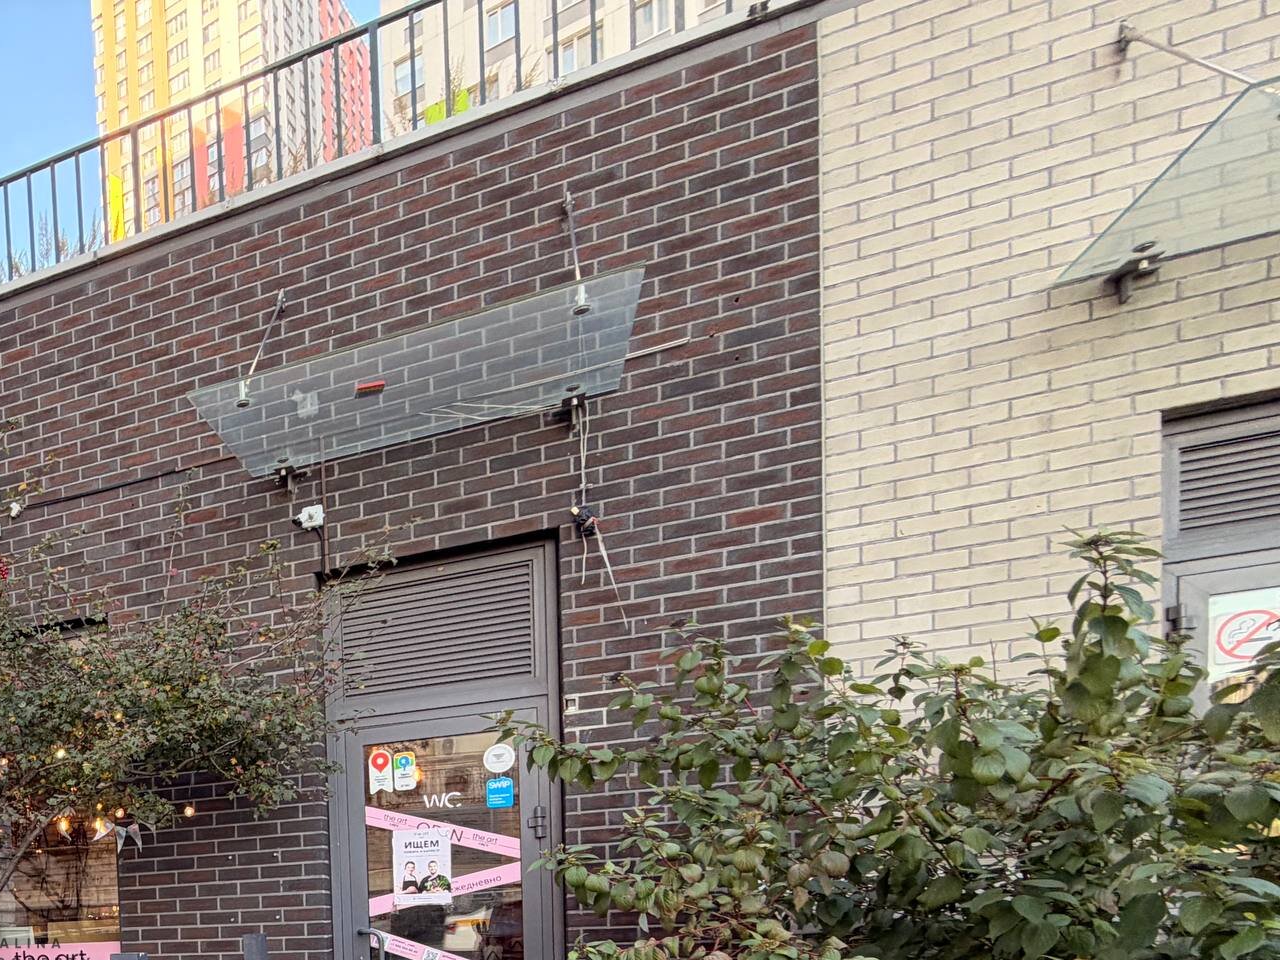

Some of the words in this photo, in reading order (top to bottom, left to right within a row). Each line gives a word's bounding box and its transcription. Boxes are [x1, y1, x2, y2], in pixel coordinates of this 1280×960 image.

[423, 791, 462, 809] WC
[404, 839, 440, 850] ИЩЕМ
[451, 875, 502, 892] жедневно
